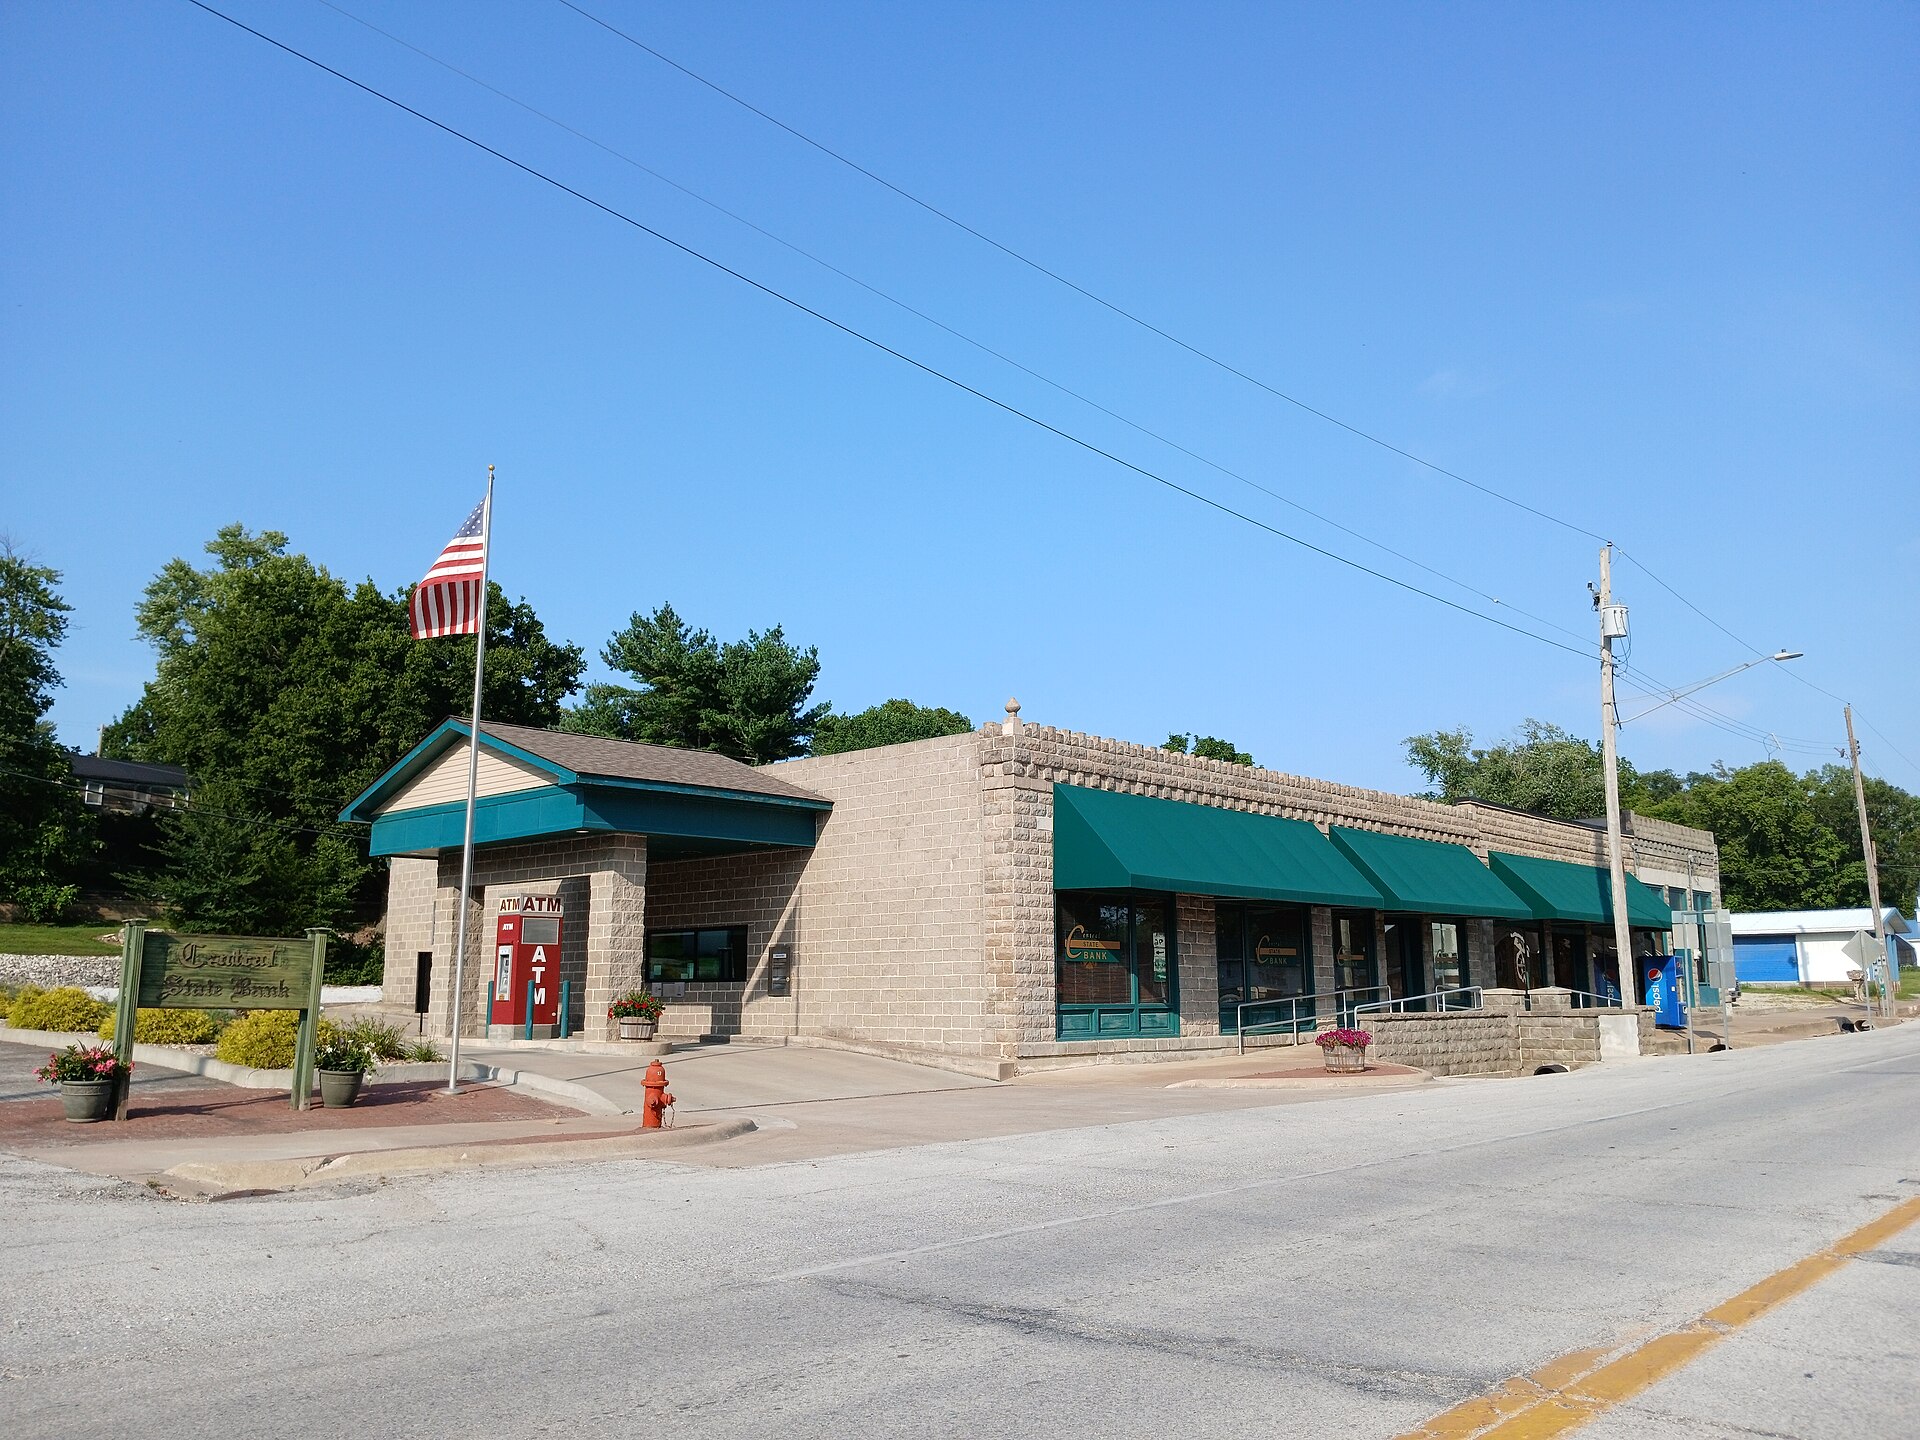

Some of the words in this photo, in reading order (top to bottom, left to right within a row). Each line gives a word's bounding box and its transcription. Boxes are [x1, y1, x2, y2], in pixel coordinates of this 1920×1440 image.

[500, 898, 520, 911] ATM
[523, 897, 561, 912] ATM
[177, 942, 279, 969] Central
[1083, 951, 1107, 960] BANK
[1269, 957, 1288, 965] BANK
[531, 945, 547, 1005] ATM
[157, 974, 223, 1001] State
[230, 976, 290, 1004] Bank
[1651, 983, 1664, 1013] pepsi
